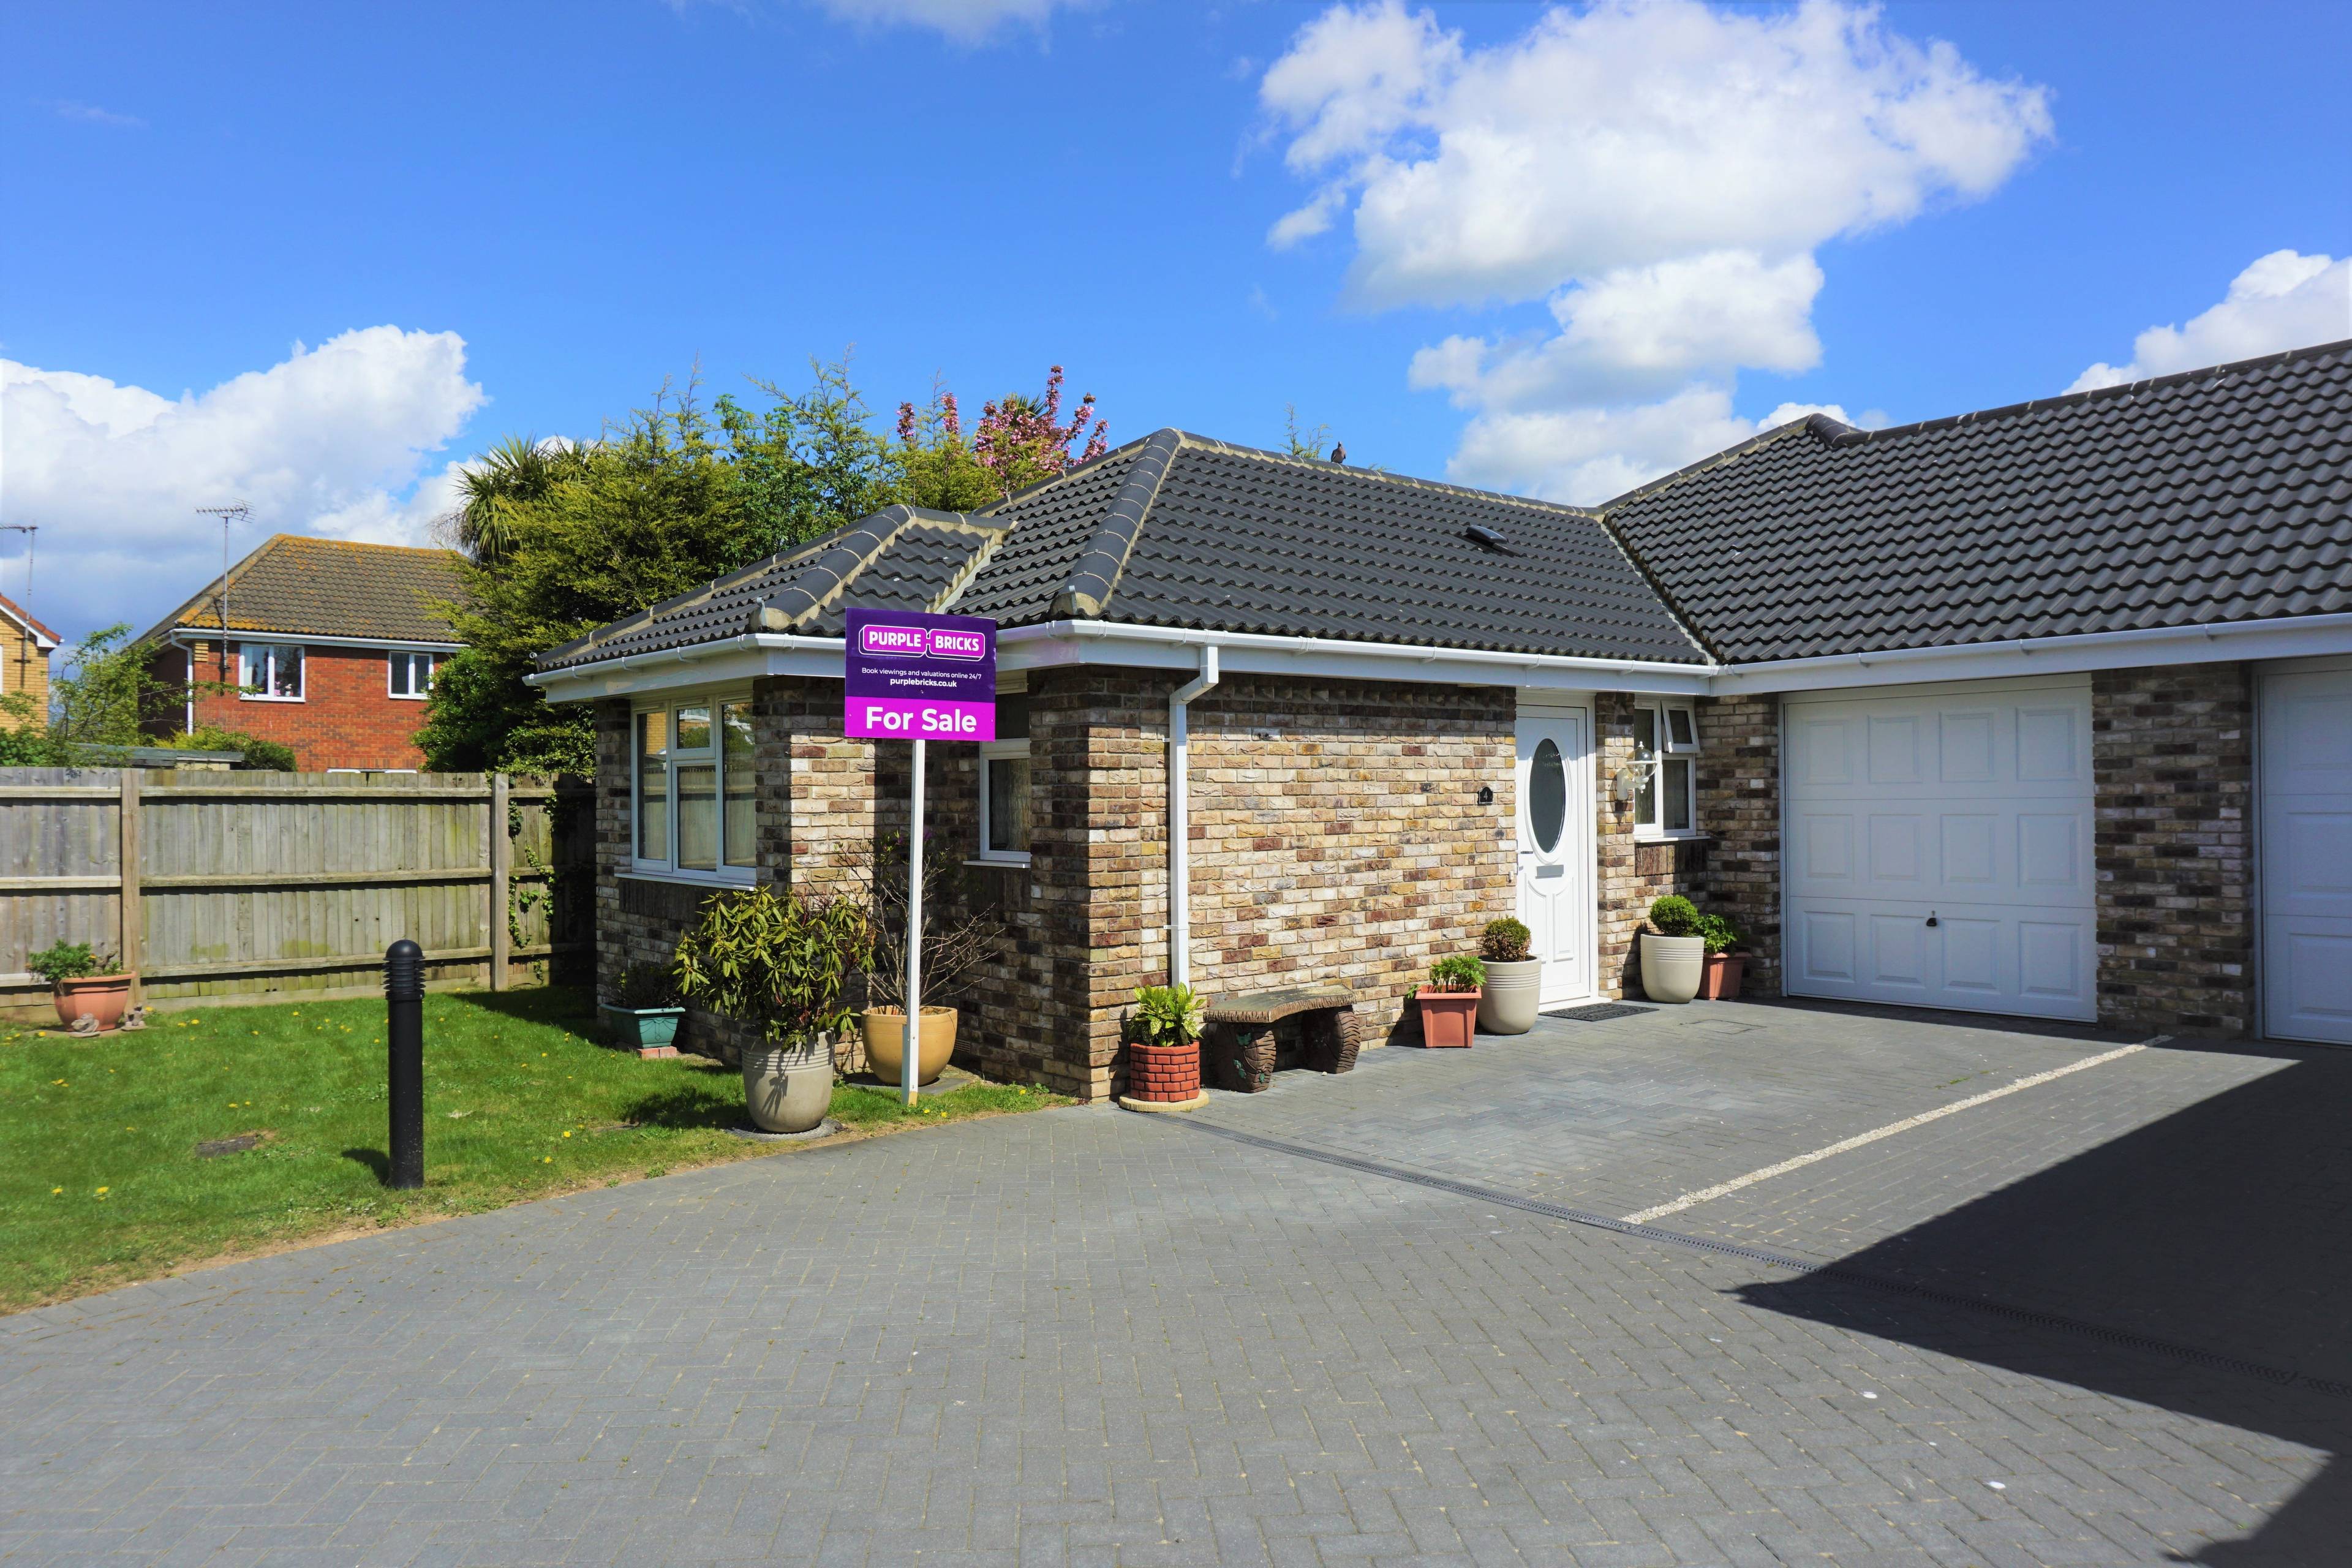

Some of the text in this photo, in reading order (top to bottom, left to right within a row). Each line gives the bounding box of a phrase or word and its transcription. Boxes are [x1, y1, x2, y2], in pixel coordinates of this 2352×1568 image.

[869, 631, 979, 652] PURPLE BRICKS
[890, 678, 957, 687] purplebricks.co.uk
[866, 706, 977, 733] For Sale
[1483, 791, 1488, 800] 4
